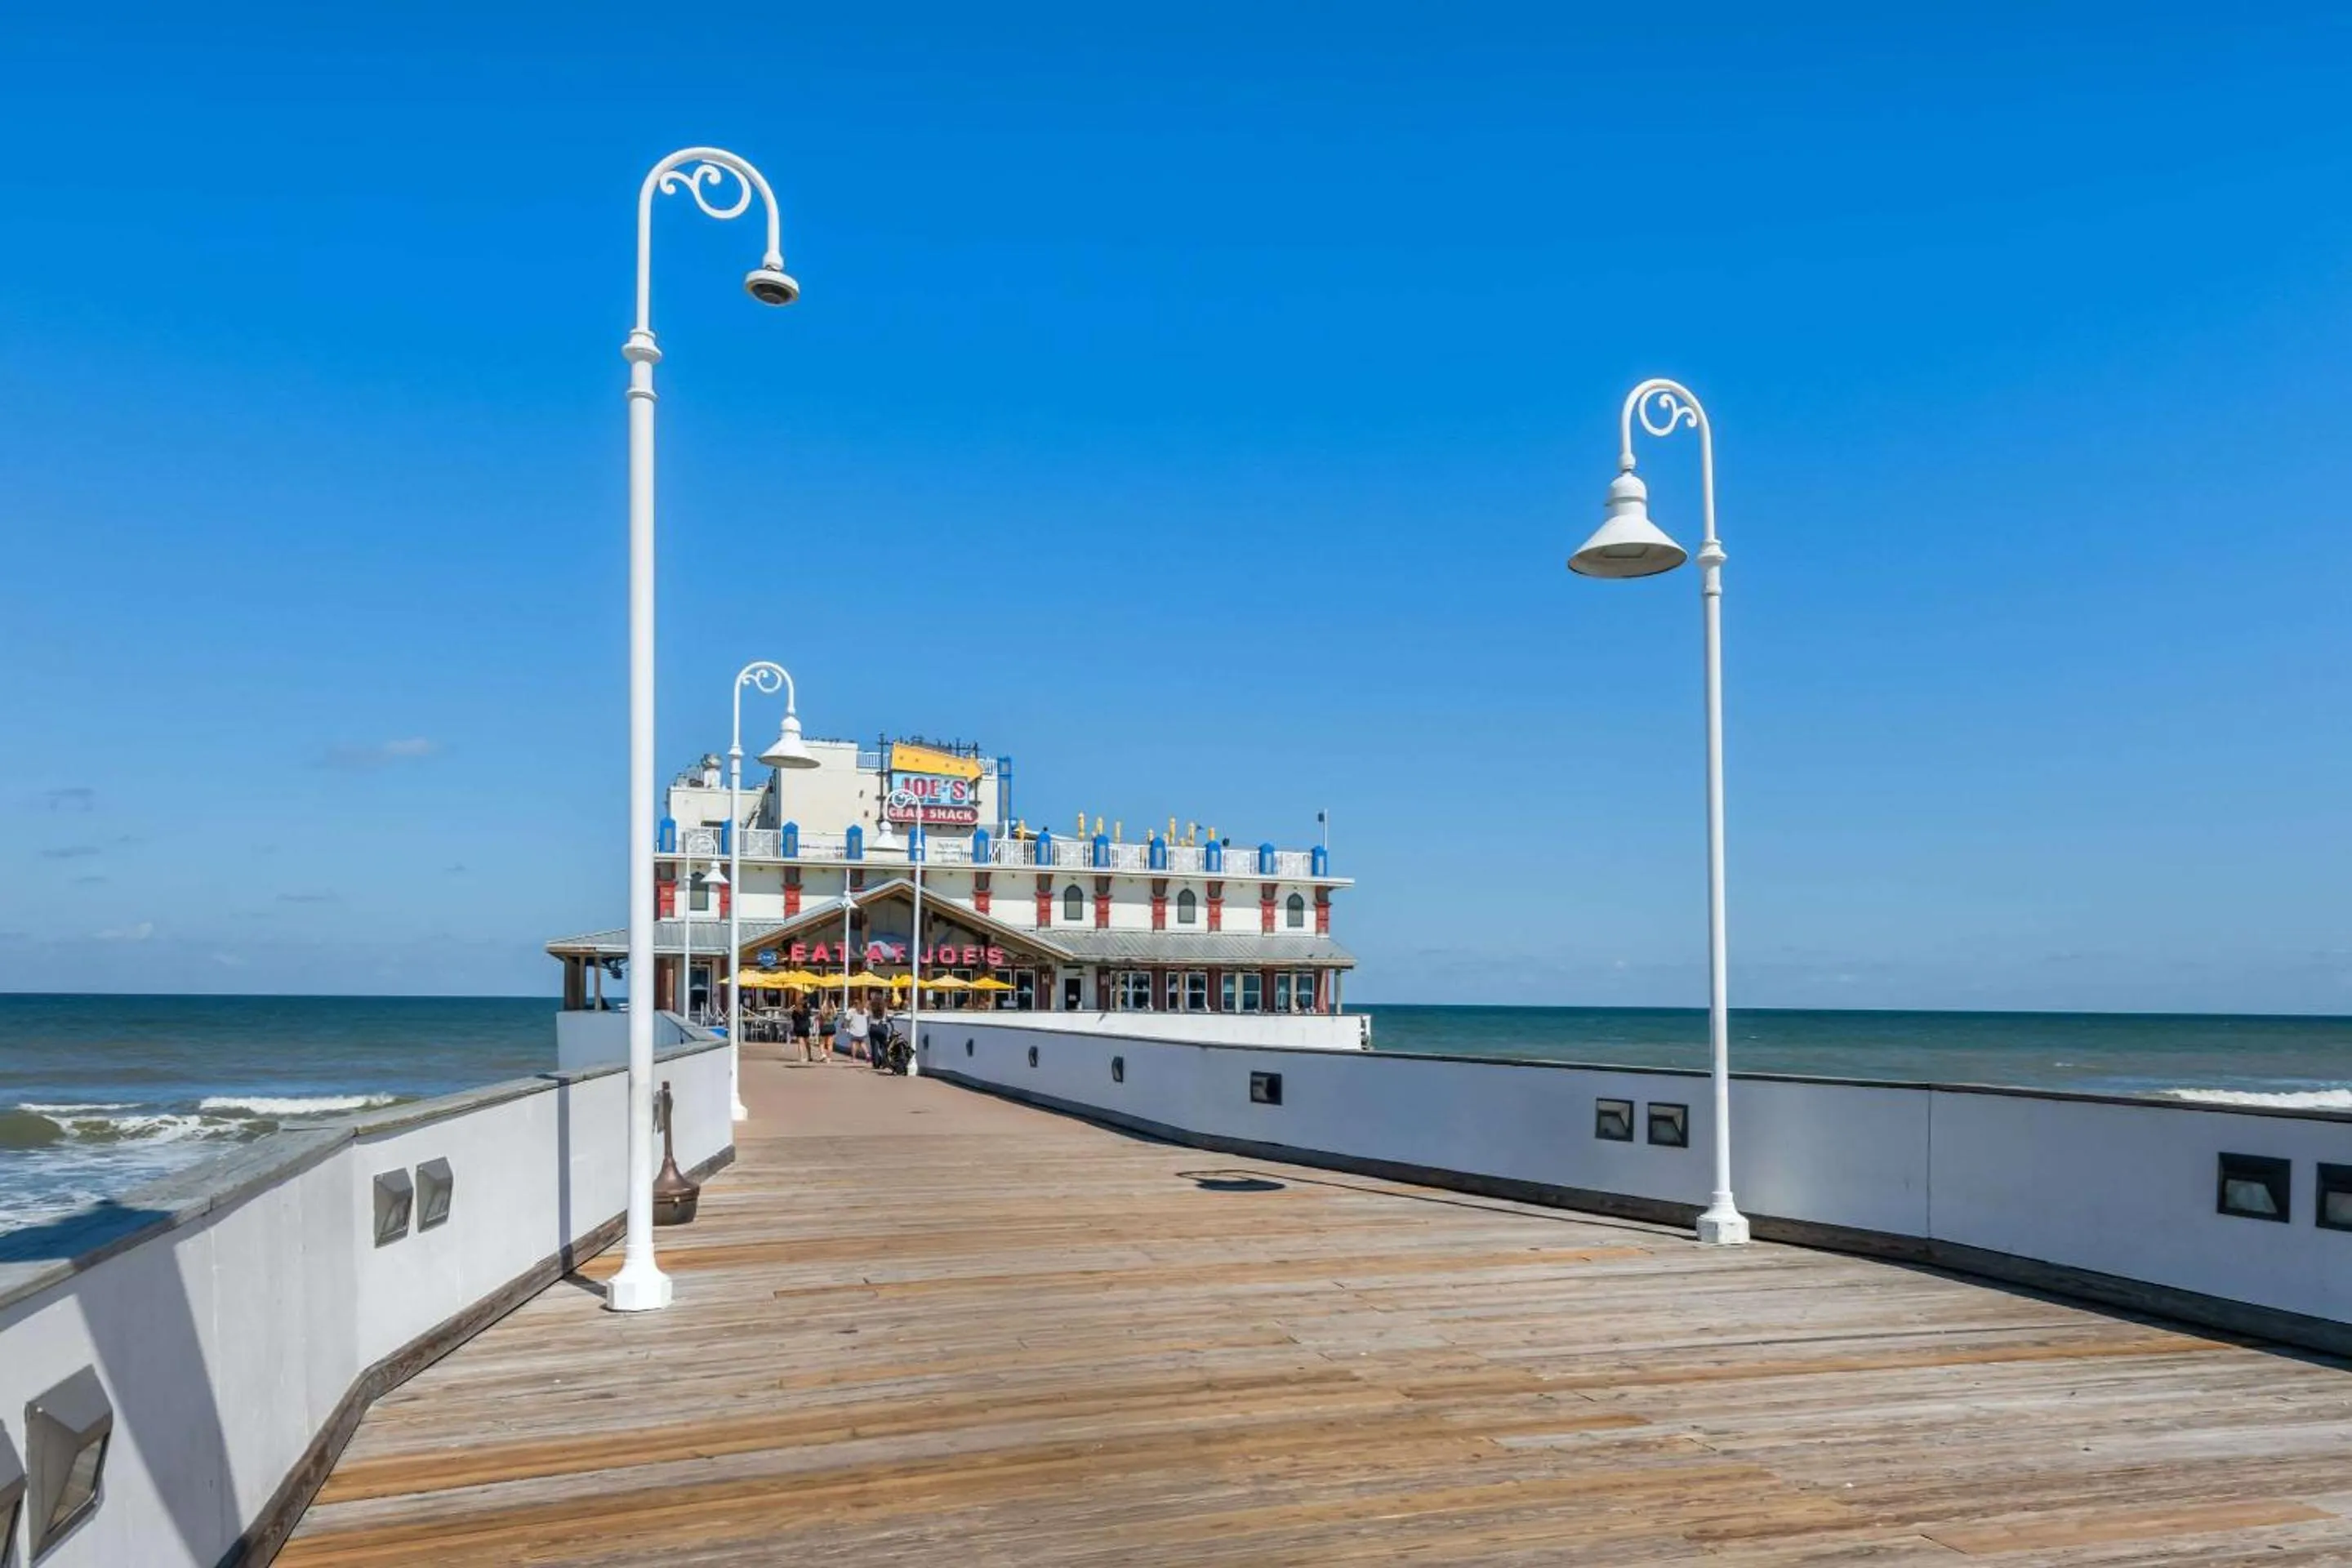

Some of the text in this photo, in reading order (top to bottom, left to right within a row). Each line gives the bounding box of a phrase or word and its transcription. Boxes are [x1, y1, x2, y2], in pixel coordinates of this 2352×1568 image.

[902, 777, 965, 800] JOE'S
[929, 808, 973, 821] SHACK
[791, 941, 847, 963] EAT
[920, 942, 1004, 966] JOE'S
